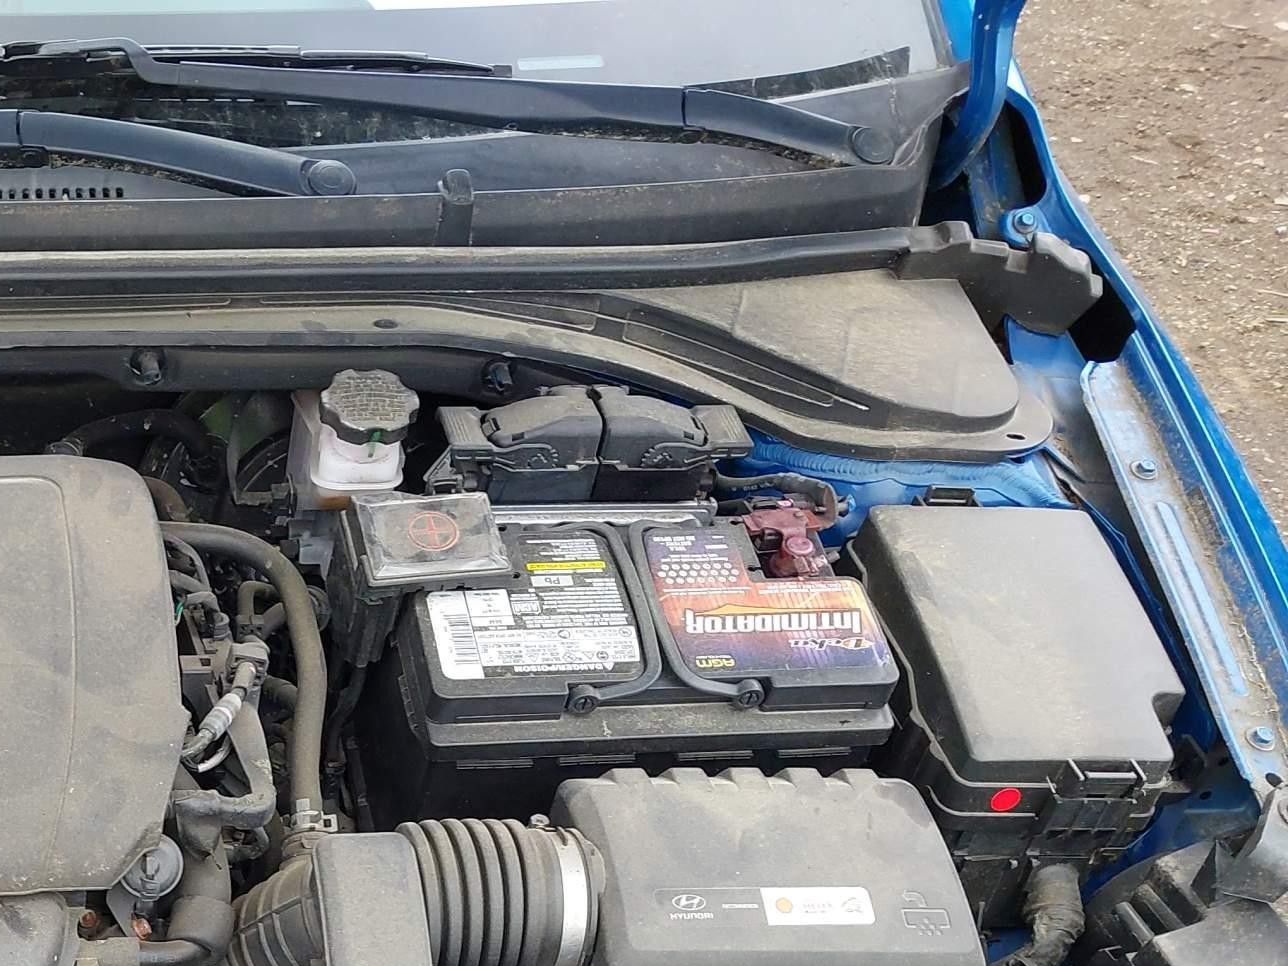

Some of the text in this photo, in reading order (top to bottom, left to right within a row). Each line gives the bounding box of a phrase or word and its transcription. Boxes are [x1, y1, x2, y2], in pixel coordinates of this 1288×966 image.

[544, 577, 561, 585] Pb
[789, 636, 864, 651] Deka
[513, 661, 604, 673] DANGER/POISON
[695, 658, 736, 668] AGM
[670, 911, 714, 920] HYUNDAI
